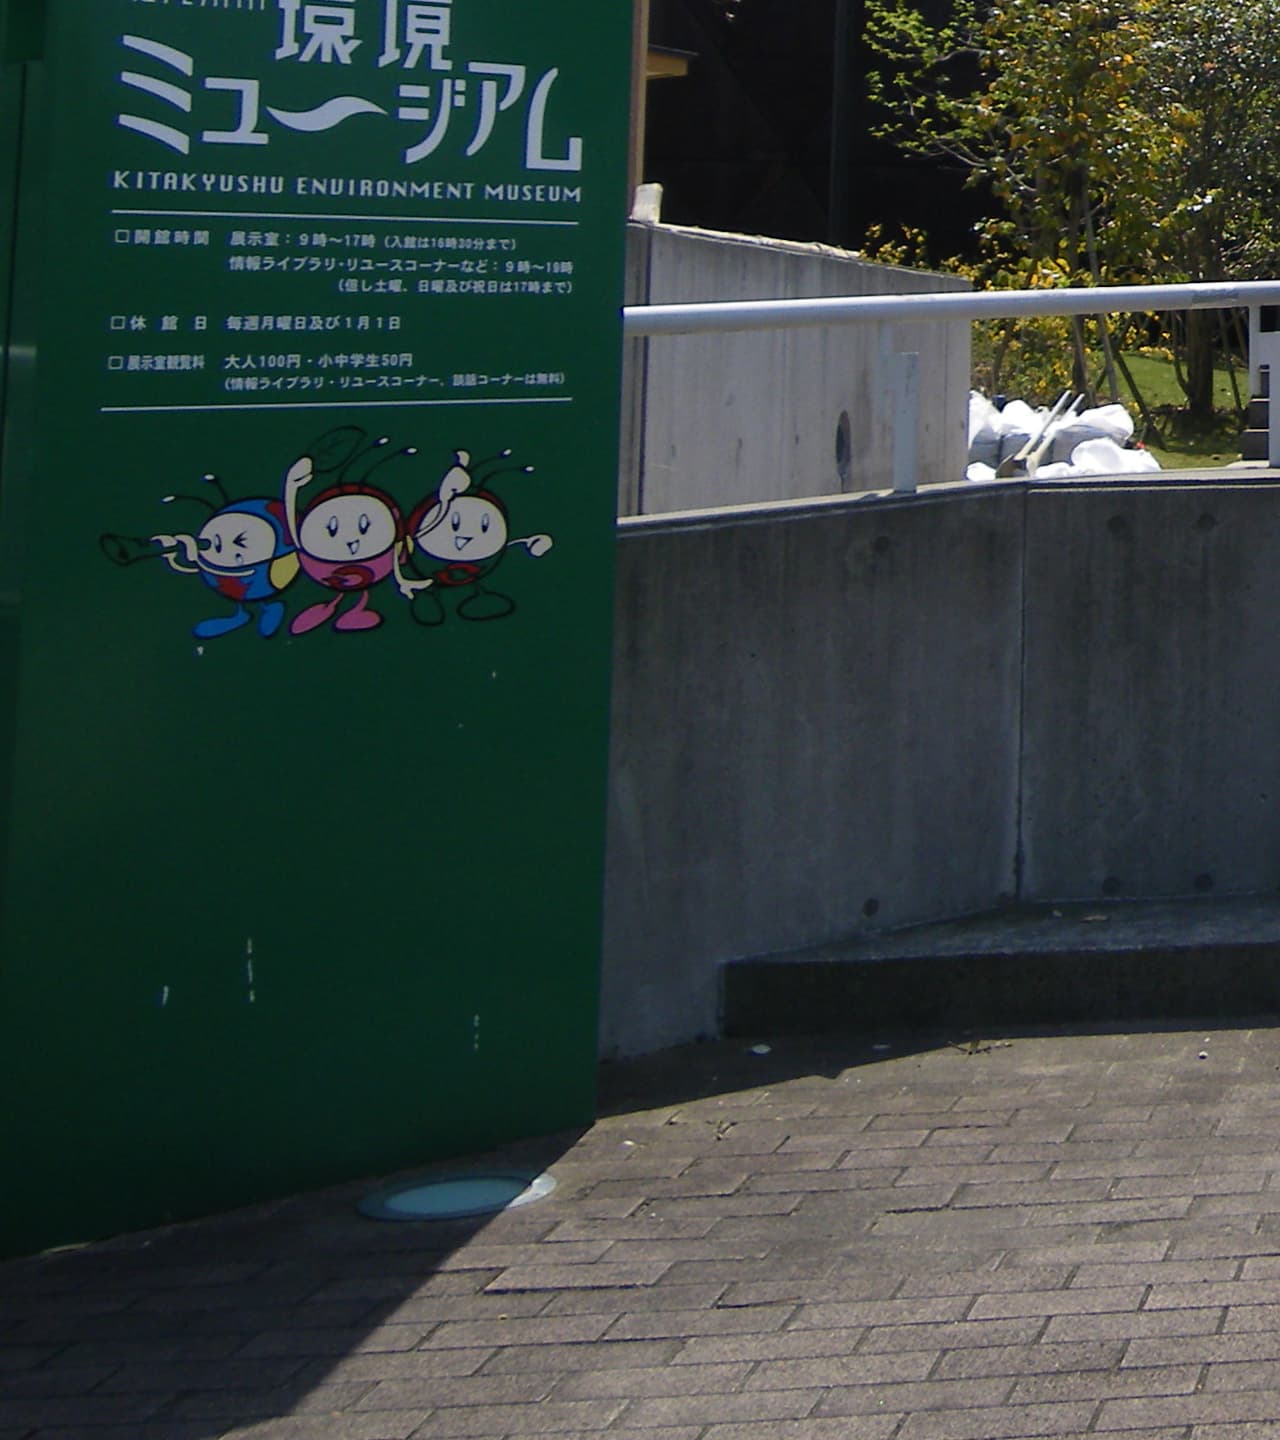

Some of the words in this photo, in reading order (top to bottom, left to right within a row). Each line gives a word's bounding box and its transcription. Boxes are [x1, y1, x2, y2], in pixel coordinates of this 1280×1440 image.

[119, 34, 583, 172] ミュージアム
[113, 170, 284, 194] KITAKYUSHU
[297, 176, 475, 200] ENVIRONMENT
[484, 183, 582, 203] MUSEUM
[134, 228, 210, 245] 開館時間
